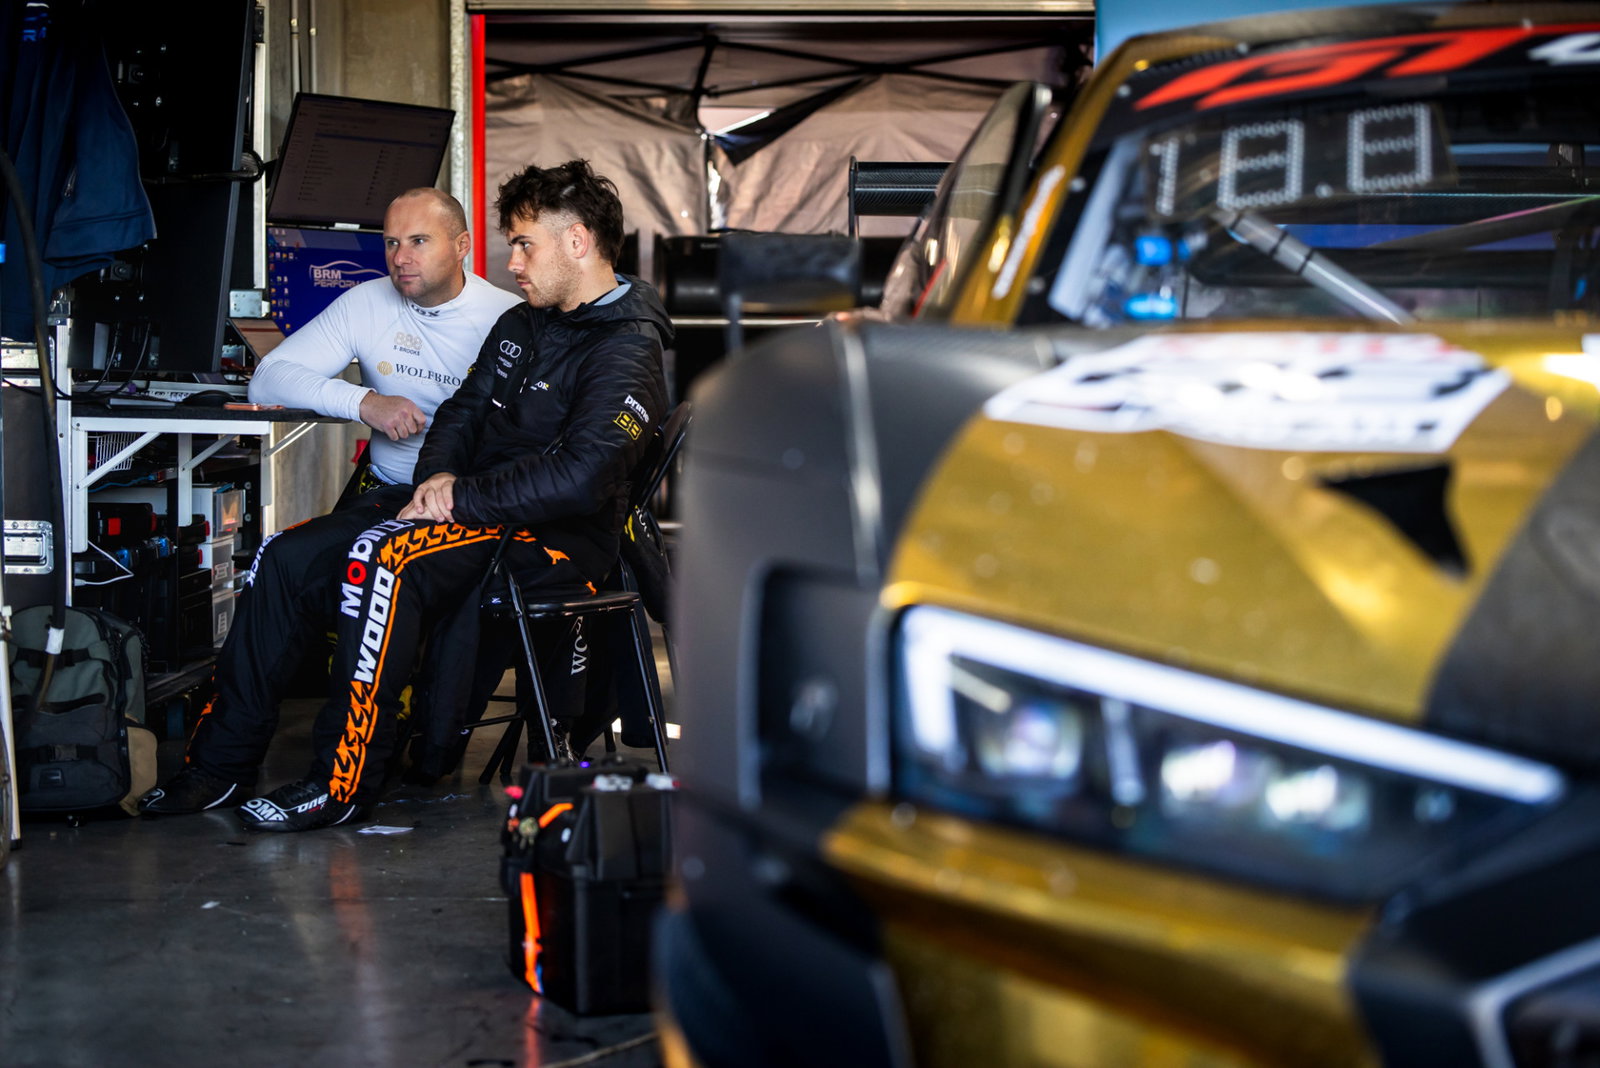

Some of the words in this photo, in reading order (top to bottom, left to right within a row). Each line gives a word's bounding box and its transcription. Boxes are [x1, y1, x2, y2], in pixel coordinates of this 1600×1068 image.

[313, 269, 342, 280] BRM
[341, 529, 387, 619] Mobil
[354, 566, 396, 684] WOOD
[246, 799, 286, 822] OMP
